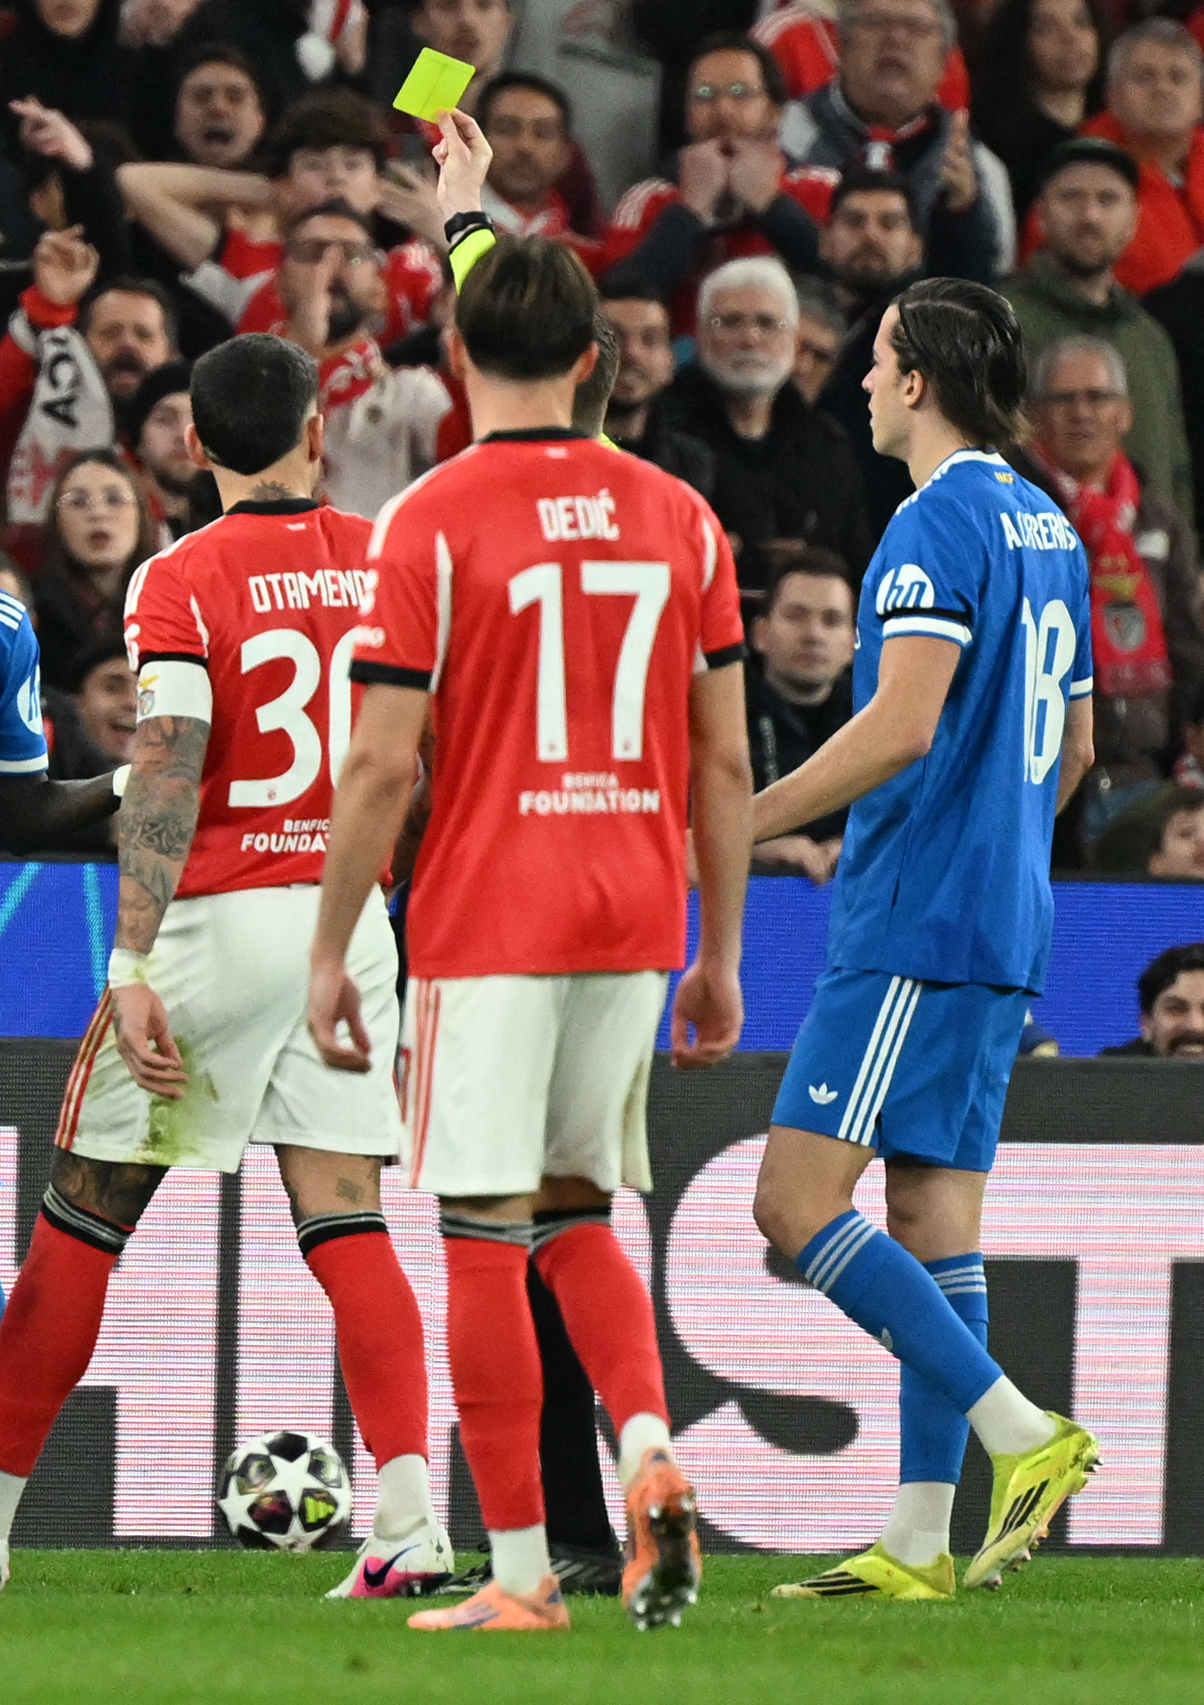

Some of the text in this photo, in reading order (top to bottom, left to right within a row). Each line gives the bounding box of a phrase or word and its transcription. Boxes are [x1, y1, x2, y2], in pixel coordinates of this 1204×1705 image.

[537, 488, 620, 541] DEDIĆ
[248, 569, 370, 613] OTAMEND
[508, 561, 671, 762] 17
[1022, 597, 1077, 784] 18
[519, 787, 660, 816] FOUNDATION
[240, 832, 332, 853] FOUNDA
[283, 819, 331, 833] BENFIC
